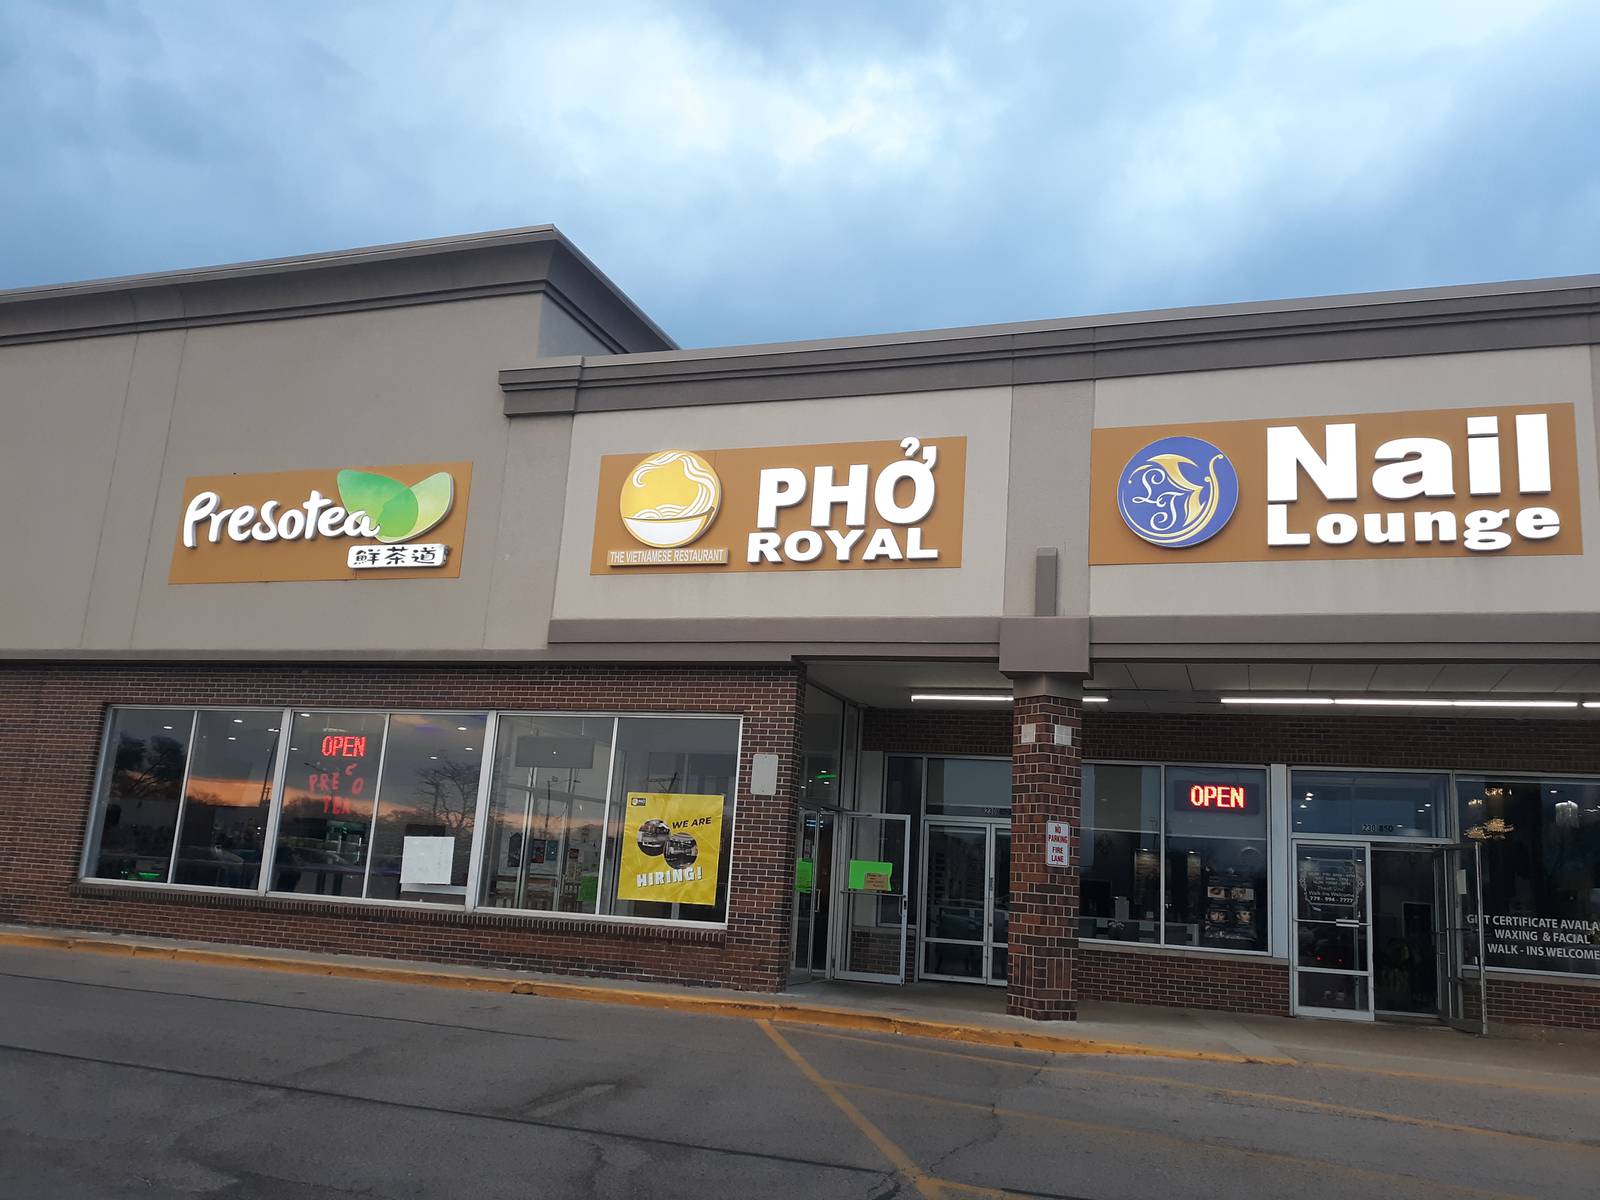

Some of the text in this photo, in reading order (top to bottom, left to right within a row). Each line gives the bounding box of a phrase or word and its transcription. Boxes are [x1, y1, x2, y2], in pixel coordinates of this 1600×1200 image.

[1266, 412, 1552, 503] Nail
[183, 490, 381, 548] Presotea
[1267, 503, 1561, 551] Lounge
[747, 527, 938, 564] ROYAL
[353, 546, 437, 566] 鮮茶道
[610, 549, 724, 563] THE VIETNAMESE RESTAURANT
[321, 735, 367, 757] OPEN
[1190, 784, 1246, 809] OPEN
[672, 816, 712, 829] WE ARE
[1048, 834, 1068, 844] PARKING
[1051, 855, 1064, 863] LANE
[1052, 846, 1064, 854] FIRE
[636, 866, 703, 888] HIRING!
[1466, 914, 1490, 925] GIT
[1492, 915, 1558, 928] CERTIFICATE
[1494, 929, 1591, 945] WAXING & FACIAL
[1487, 943, 1519, 955] WALK
[1526, 945, 1544, 956] INS
[1546, 947, 1600, 960] WELCOME
